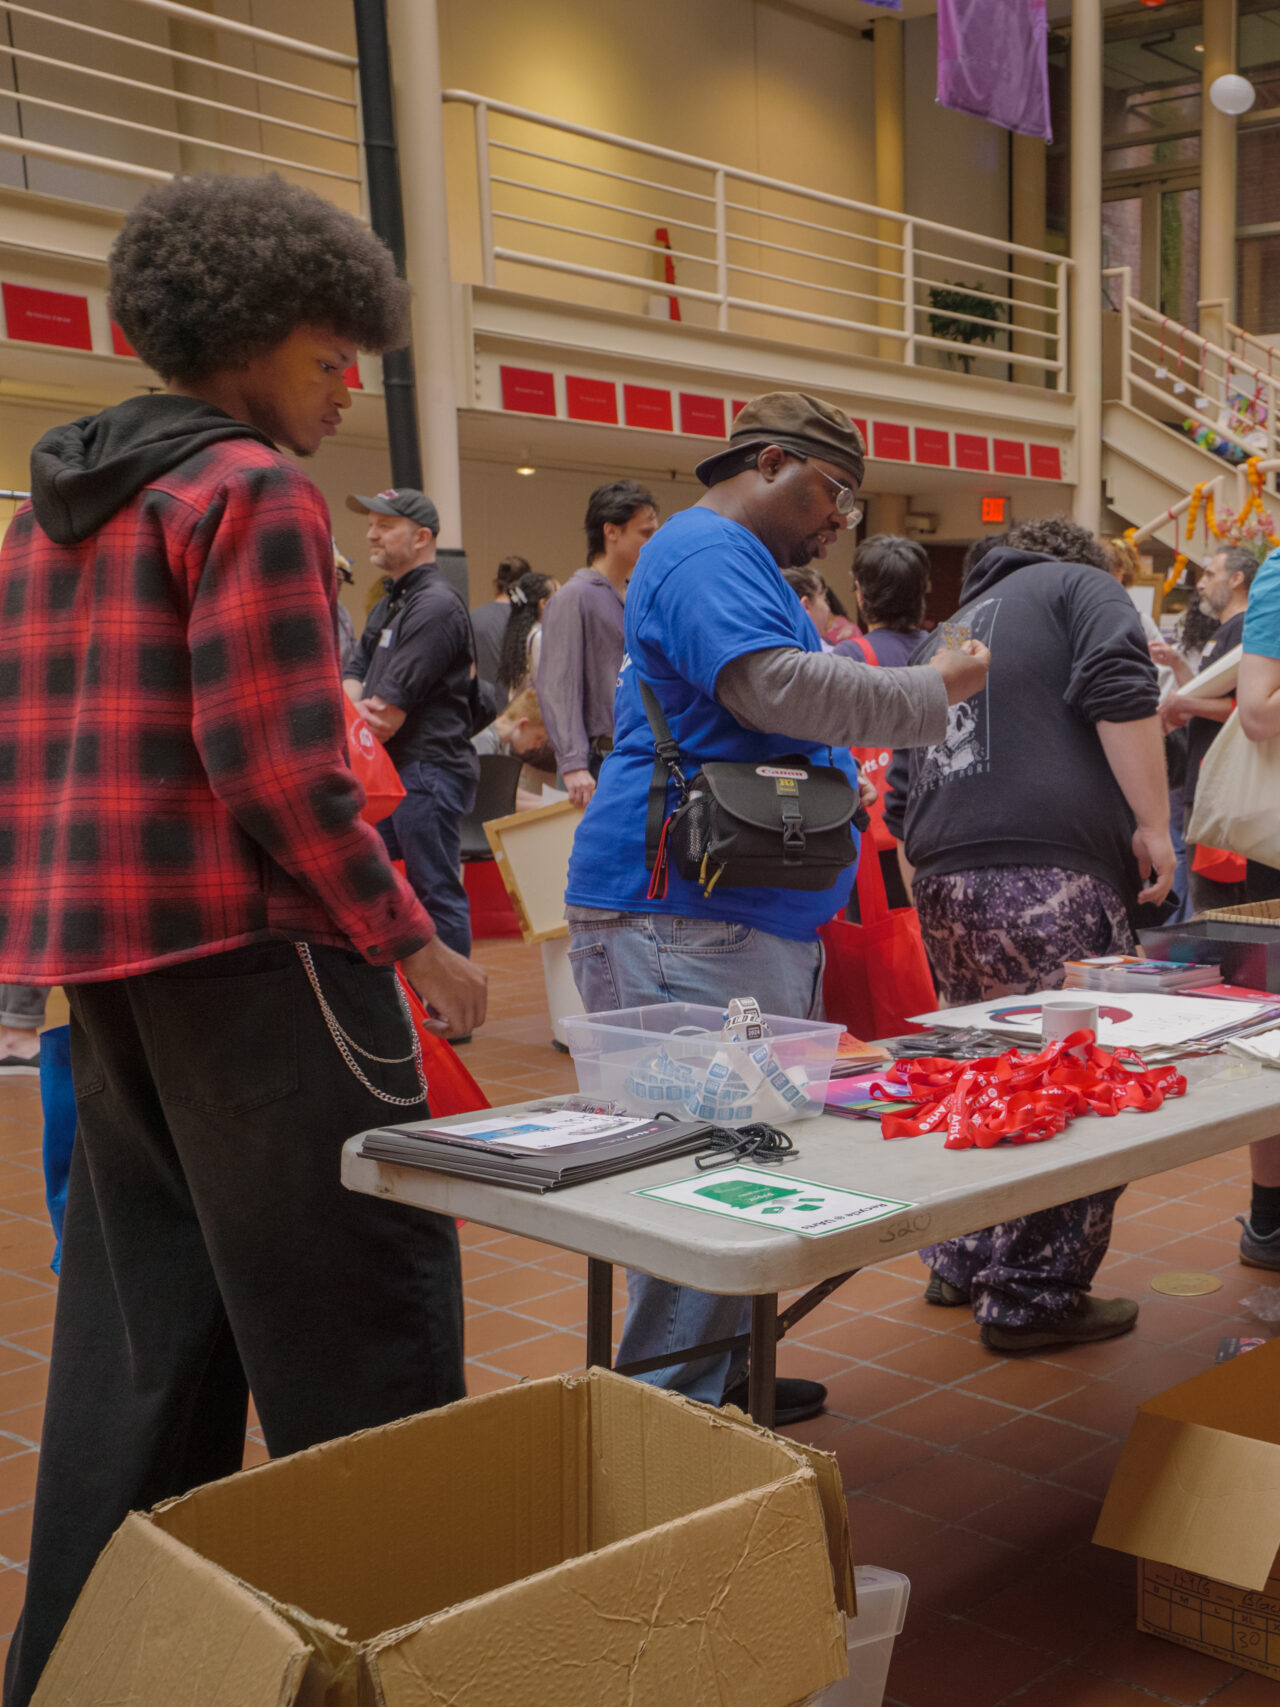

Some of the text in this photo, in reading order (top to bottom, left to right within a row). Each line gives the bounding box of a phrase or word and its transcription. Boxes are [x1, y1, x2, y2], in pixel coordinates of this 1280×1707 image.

[760, 768, 804, 778] Canon
[928, 1104, 948, 1125] Arts
[950, 1114, 962, 1135] Arts
[1180, 1596, 1189, 1604] M
[1213, 1607, 1221, 1615] L
[1241, 1615, 1256, 1625] XL
[1236, 1631, 1261, 1649] 30
